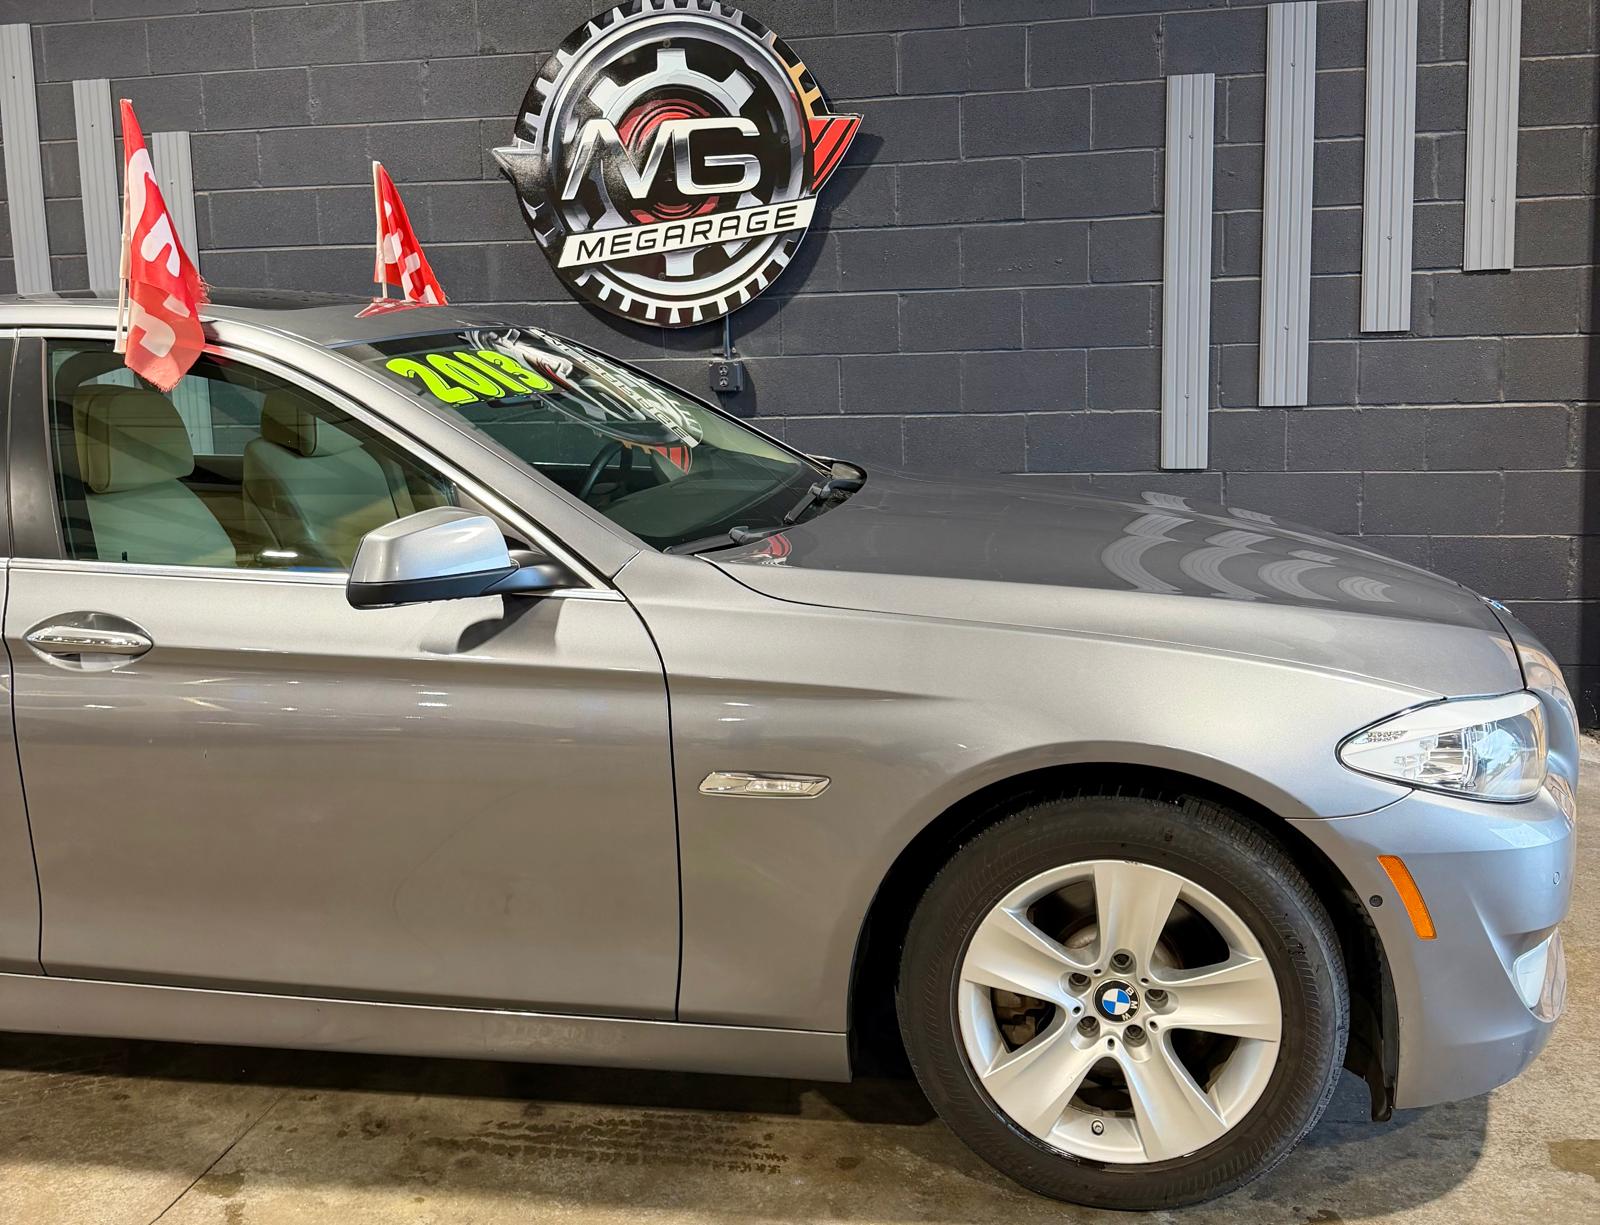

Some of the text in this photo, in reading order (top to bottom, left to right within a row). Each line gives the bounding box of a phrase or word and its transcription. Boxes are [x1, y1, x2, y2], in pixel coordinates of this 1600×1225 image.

[561, 117, 761, 200] MG
[576, 205, 798, 261] MEGARAGE
[385, 350, 554, 405] 2013
